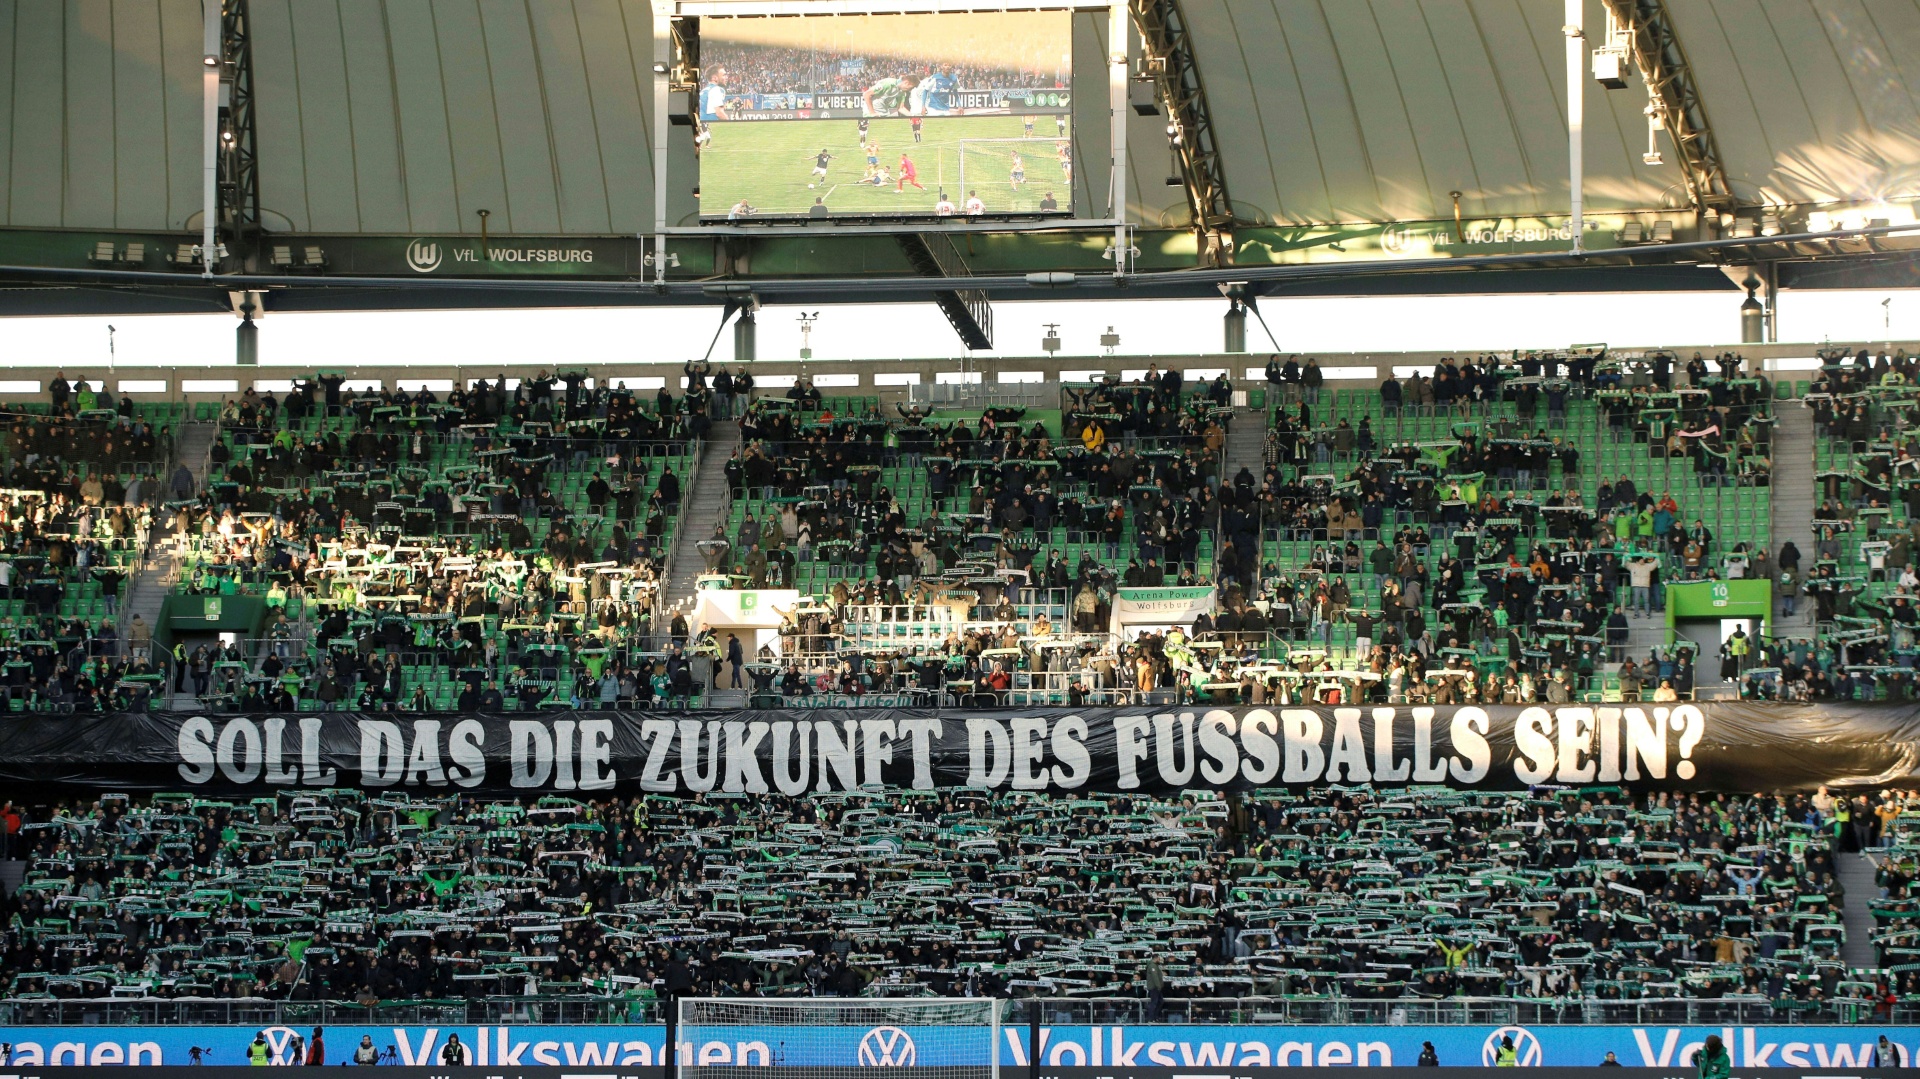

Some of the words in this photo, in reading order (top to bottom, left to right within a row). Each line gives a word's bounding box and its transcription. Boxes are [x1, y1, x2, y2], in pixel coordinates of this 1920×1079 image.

[1428, 232, 1454, 246] VfL
[1464, 228, 1572, 244] WOLFSBURG
[453, 248, 479, 262] VfL
[488, 248, 593, 263] WOLFSBURG
[1132, 591, 1163, 600] Arena
[1169, 590, 1200, 599] Power
[1712, 586, 1728, 597] 10
[209, 602, 217, 611] 4
[745, 596, 753, 606] 6
[1136, 601, 1195, 610] Wolfsburg
[177, 716, 337, 786] SOLL
[357, 719, 486, 788] DAS
[509, 719, 617, 790] DIE
[639, 718, 943, 797] ZUKUNFT
[965, 715, 1092, 790] DES
[1113, 706, 1493, 789] FUSSBALLS
[1513, 704, 1704, 784] SEIN?
[0, 1042, 163, 1066] agen
